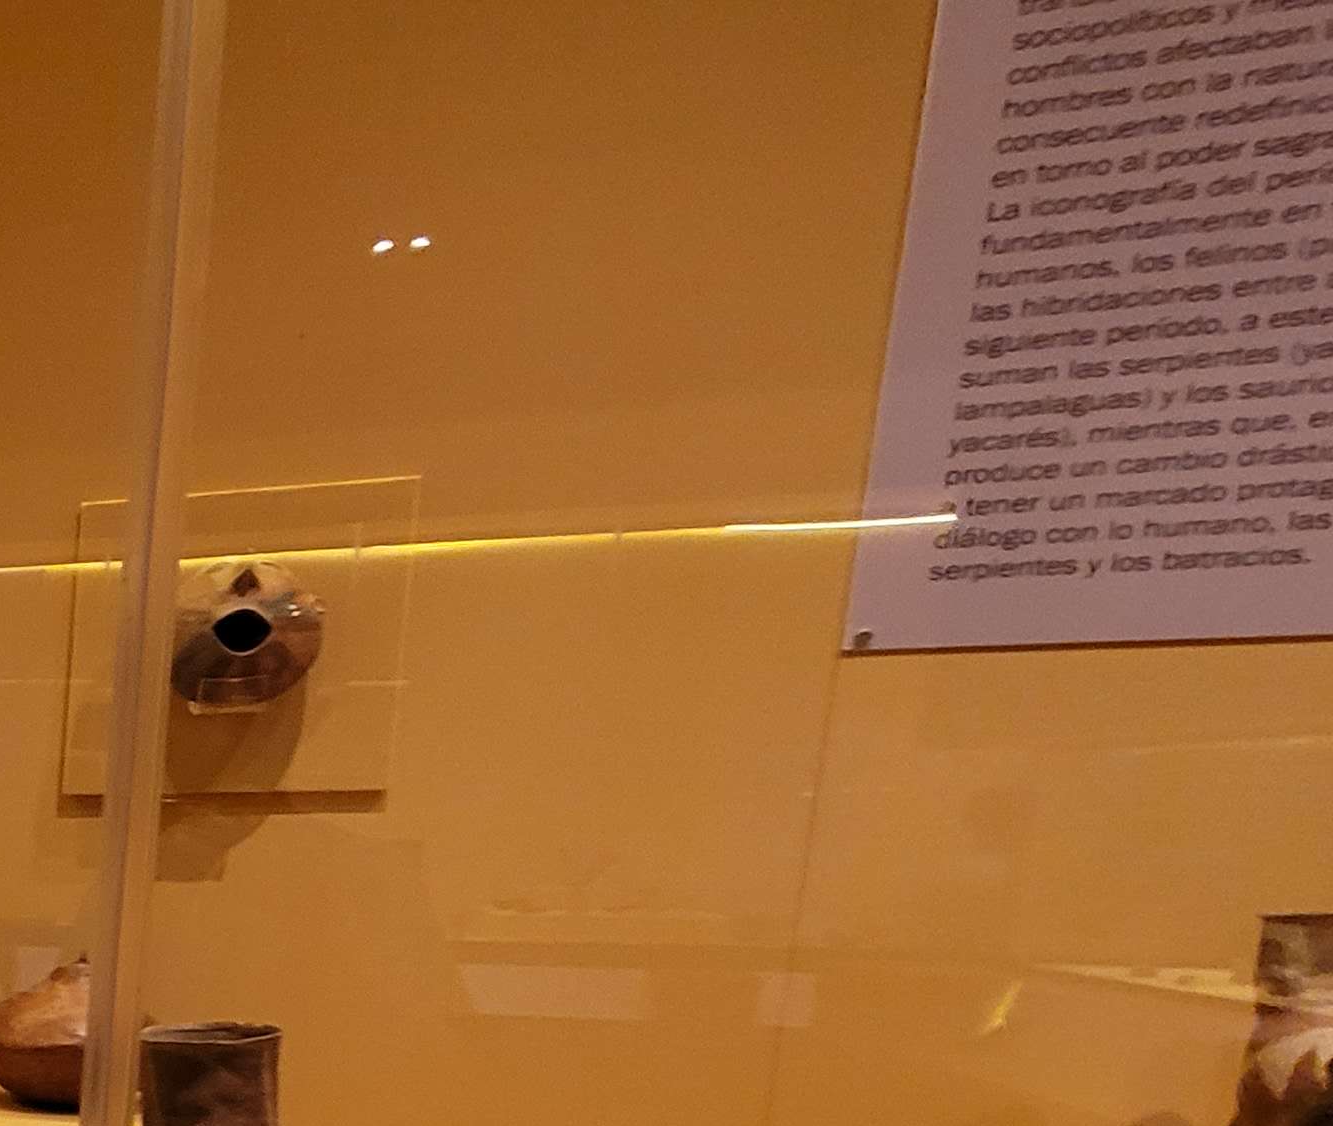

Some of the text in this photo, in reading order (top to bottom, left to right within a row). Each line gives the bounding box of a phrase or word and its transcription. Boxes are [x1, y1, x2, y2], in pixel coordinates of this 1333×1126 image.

[1005, 49, 1148, 86] conflictos
[1154, 25, 1315, 65] afectaban
[1000, 86, 1133, 119] hombres
[1140, 77, 1197, 101] con
[1205, 72, 1233, 94] la
[995, 113, 1187, 155] consecuente
[990, 168, 1028, 189] en
[1035, 157, 1113, 185] torno
[1153, 141, 1249, 172] poder
[986, 201, 1021, 223] La
[1030, 175, 1198, 216] iconografía
[1206, 171, 1258, 197] del
[980, 203, 1325, 255] fundamentalmente en
[1132, 253, 1175, 275] los
[1185, 239, 1288, 268] felinos
[968, 302, 1013, 323] las
[1021, 282, 1223, 318] hibridaciones
[1231, 272, 1318, 298] entre
[964, 328, 1098, 359] siguiente
[1239, 312, 1260, 332] a
[958, 364, 1060, 389] suman
[1069, 358, 1113, 381] las
[1118, 346, 1281, 377] serpientes
[1185, 382, 1230, 404] los
[1085, 414, 1223, 444] mientras
[943, 457, 1063, 488] produce
[1068, 457, 1109, 479] un
[1116, 446, 1229, 476] cambio
[965, 494, 1042, 518] tener
[1047, 489, 1088, 512] un
[1095, 482, 1229, 510] marcado
[933, 520, 1038, 553] diálogo
[1044, 521, 1100, 545] con
[1108, 518, 1134, 541] lo
[928, 545, 1313, 583] serpientes y los batracios.
